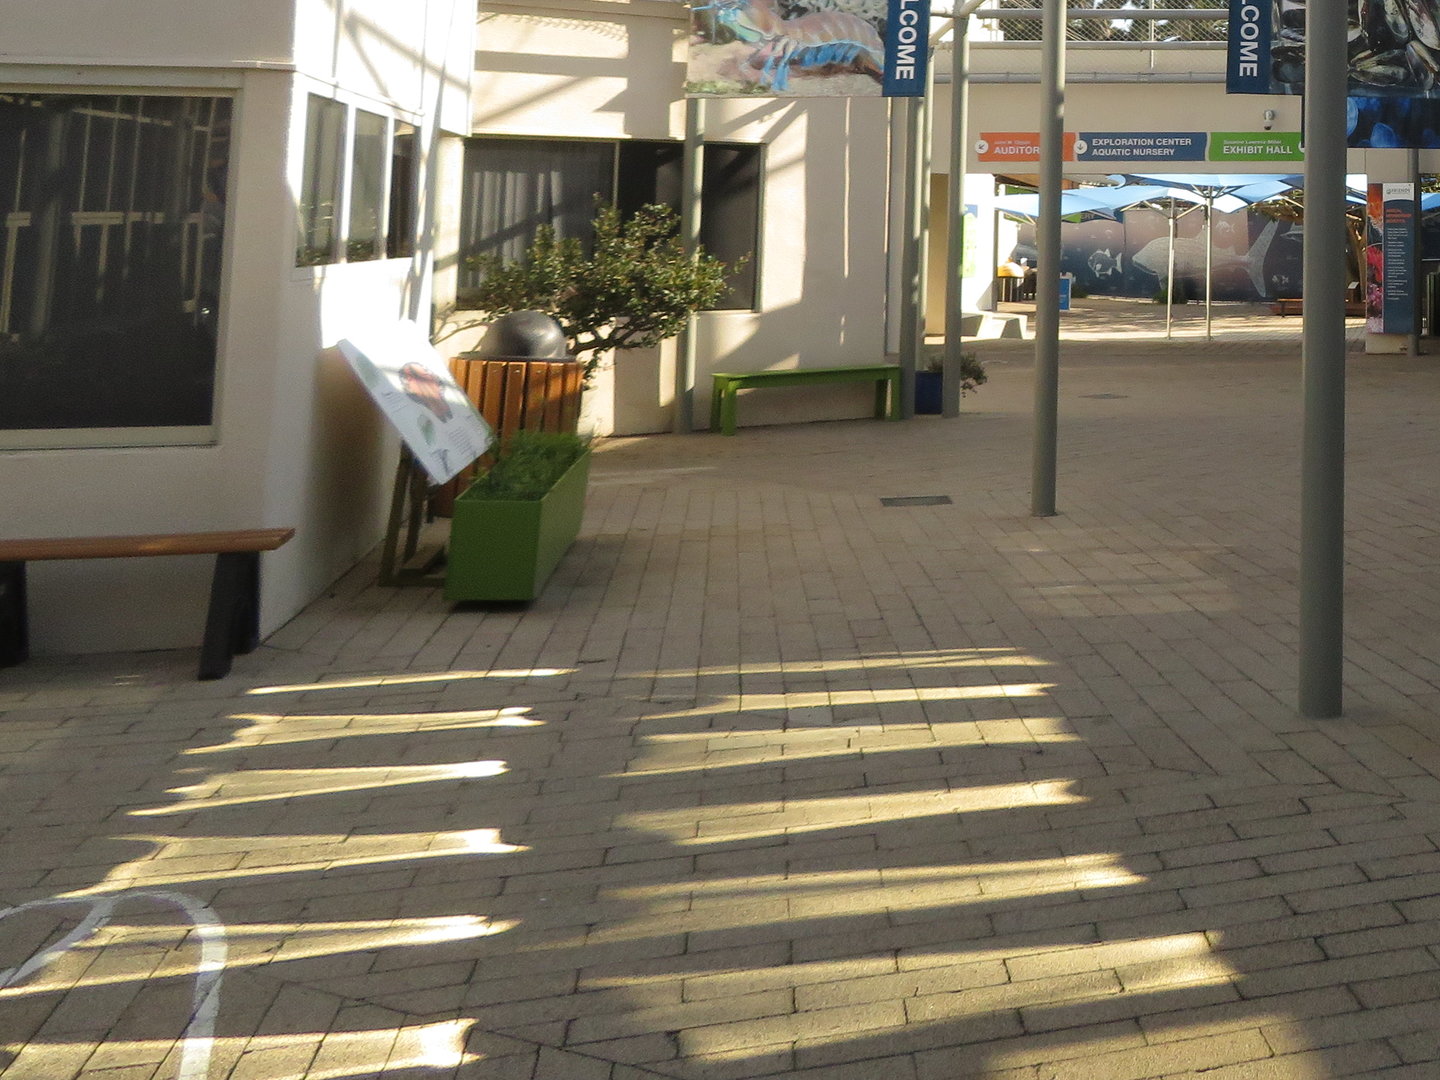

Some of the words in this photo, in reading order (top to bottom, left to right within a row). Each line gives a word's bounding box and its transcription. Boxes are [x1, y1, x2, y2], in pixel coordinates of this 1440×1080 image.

[1092, 138, 1152, 146] EXPLORATION
[1155, 138, 1192, 146] CENTER
[993, 146, 1040, 155] AUDITOR
[1092, 148, 1131, 157] AQUATIC
[1133, 148, 1175, 156] NURSERY
[1223, 145, 1264, 154] EXHIBIT
[1266, 145, 1293, 154] HALL
